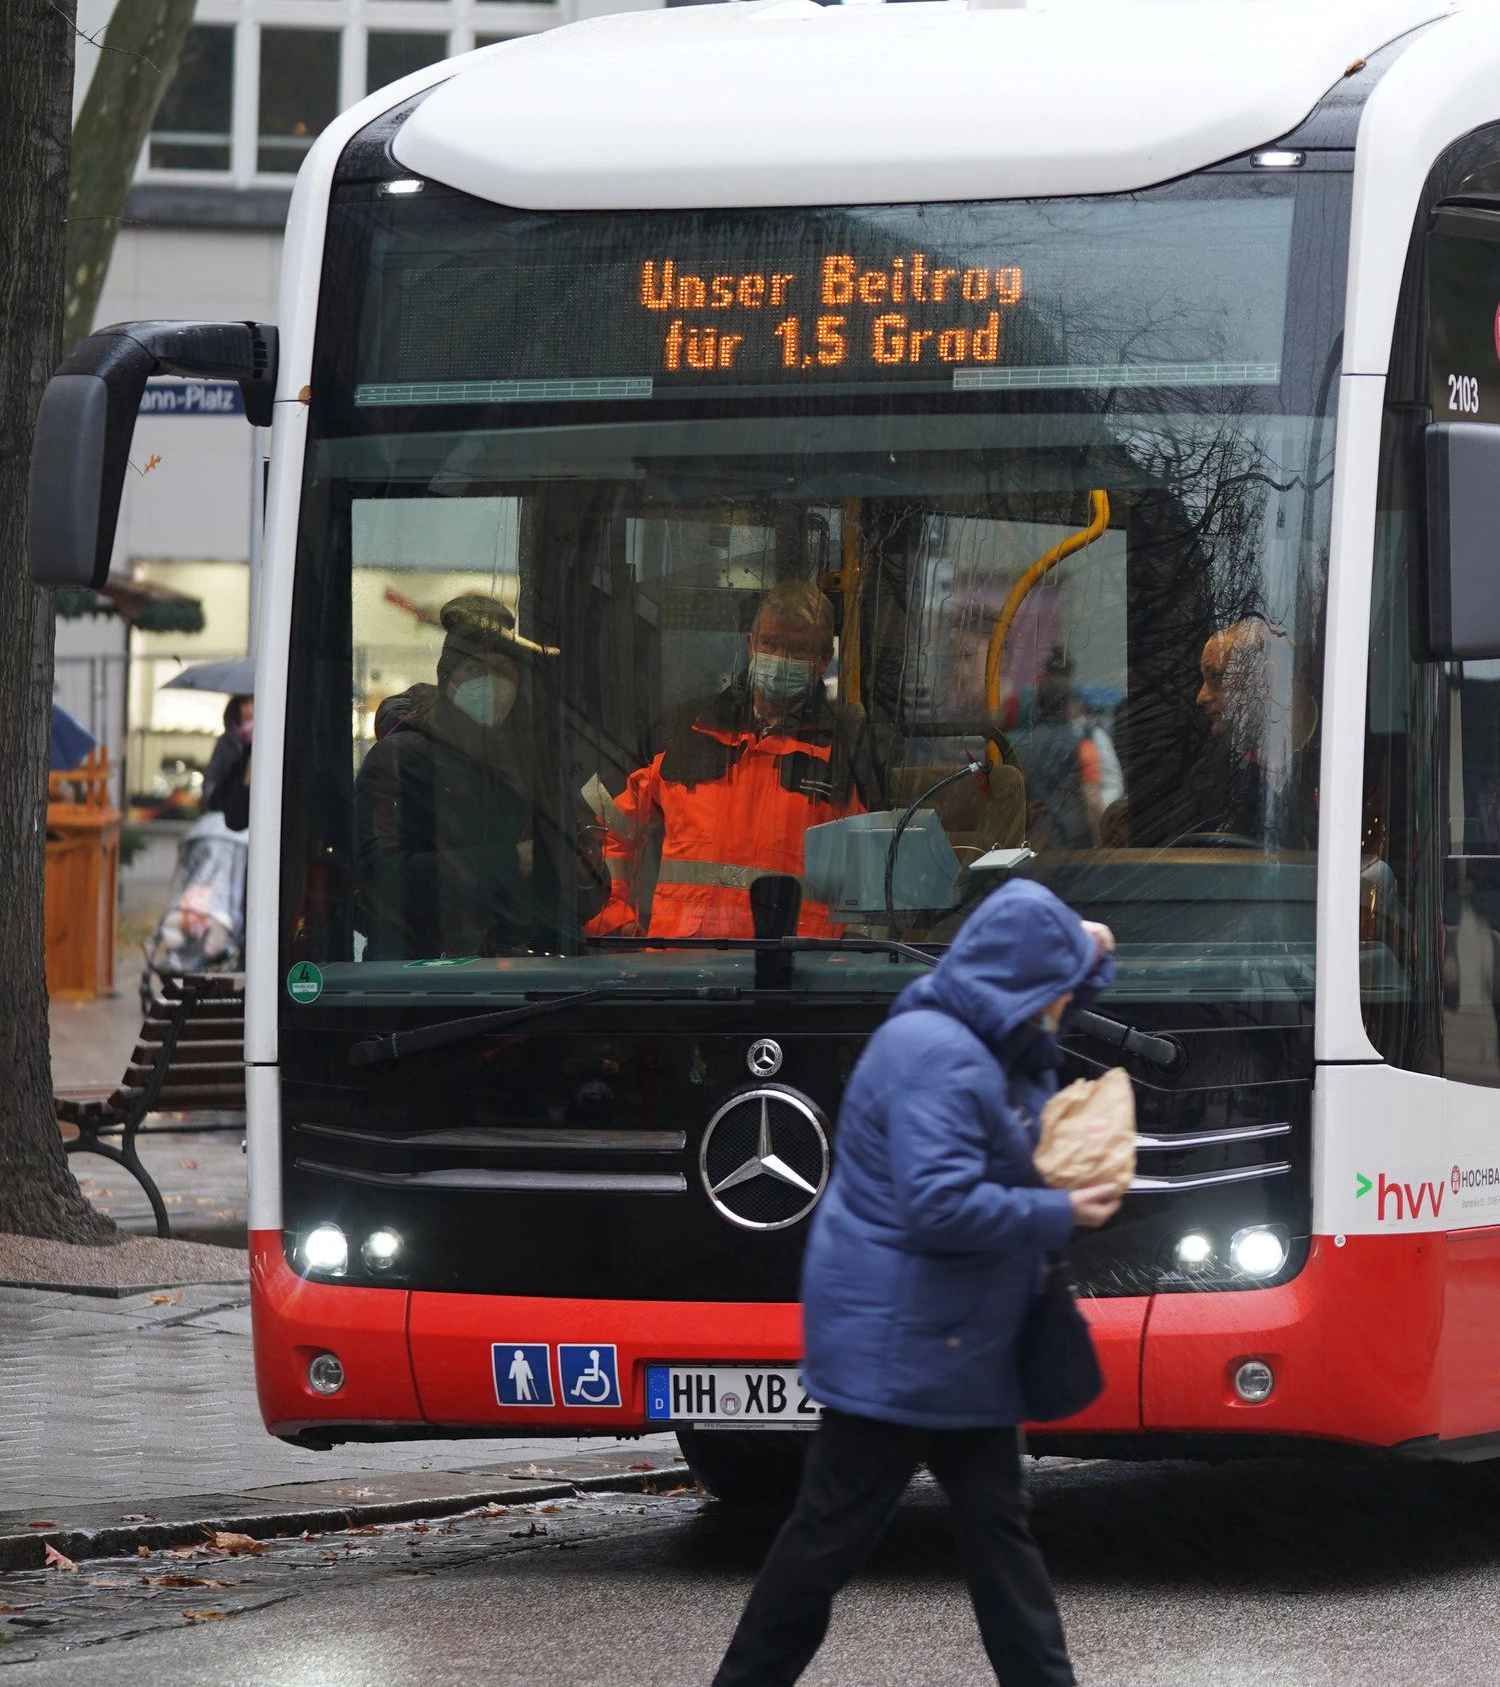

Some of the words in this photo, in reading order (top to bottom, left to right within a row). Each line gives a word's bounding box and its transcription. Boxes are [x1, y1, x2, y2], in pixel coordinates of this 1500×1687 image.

[639, 257, 793, 310] Unser
[821, 252, 1023, 306] Beitrag
[664, 317, 744, 371] für
[774, 313, 848, 369] 1,5
[872, 311, 999, 365] Grad
[139, 384, 234, 411] ann-Platz
[1448, 373, 1479, 414] 2103
[300, 964, 310, 982] 4
[1377, 1172, 1446, 1221] hvv
[655, 1397, 664, 1411] D
[673, 1374, 717, 1414] HH
[744, 1374, 788, 1414] XB
[797, 1375, 822, 1414] 2
